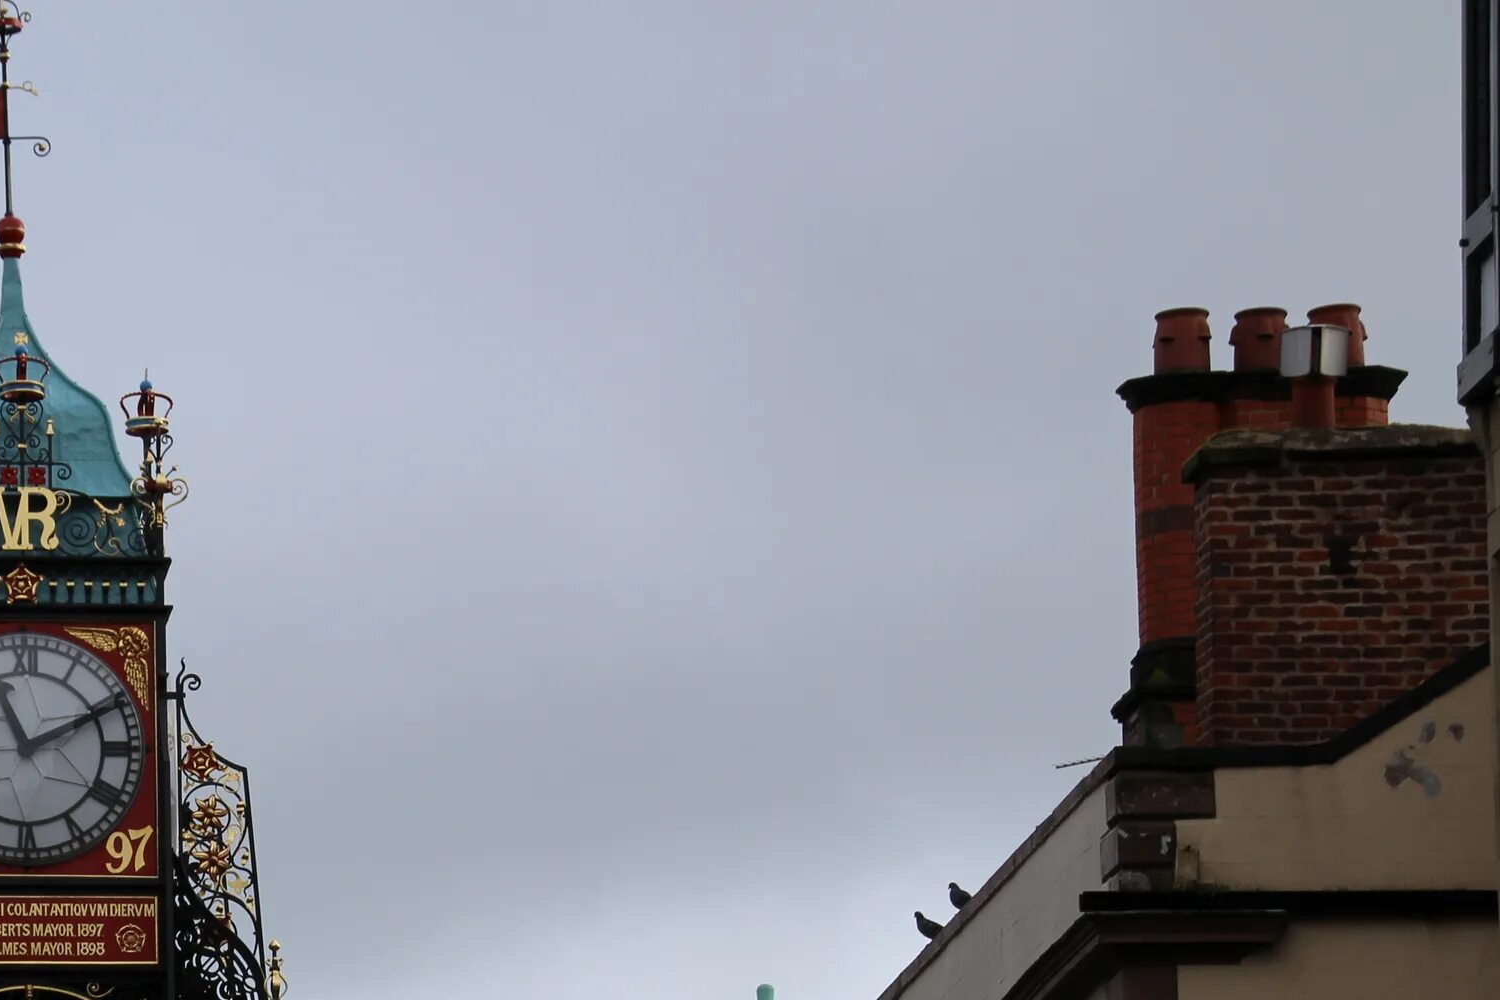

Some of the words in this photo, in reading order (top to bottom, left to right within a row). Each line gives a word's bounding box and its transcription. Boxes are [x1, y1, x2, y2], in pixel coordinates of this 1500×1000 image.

[105, 824, 155, 874] 97
[109, 903, 155, 917] DIERVM
[76, 941, 106, 956] 1898
